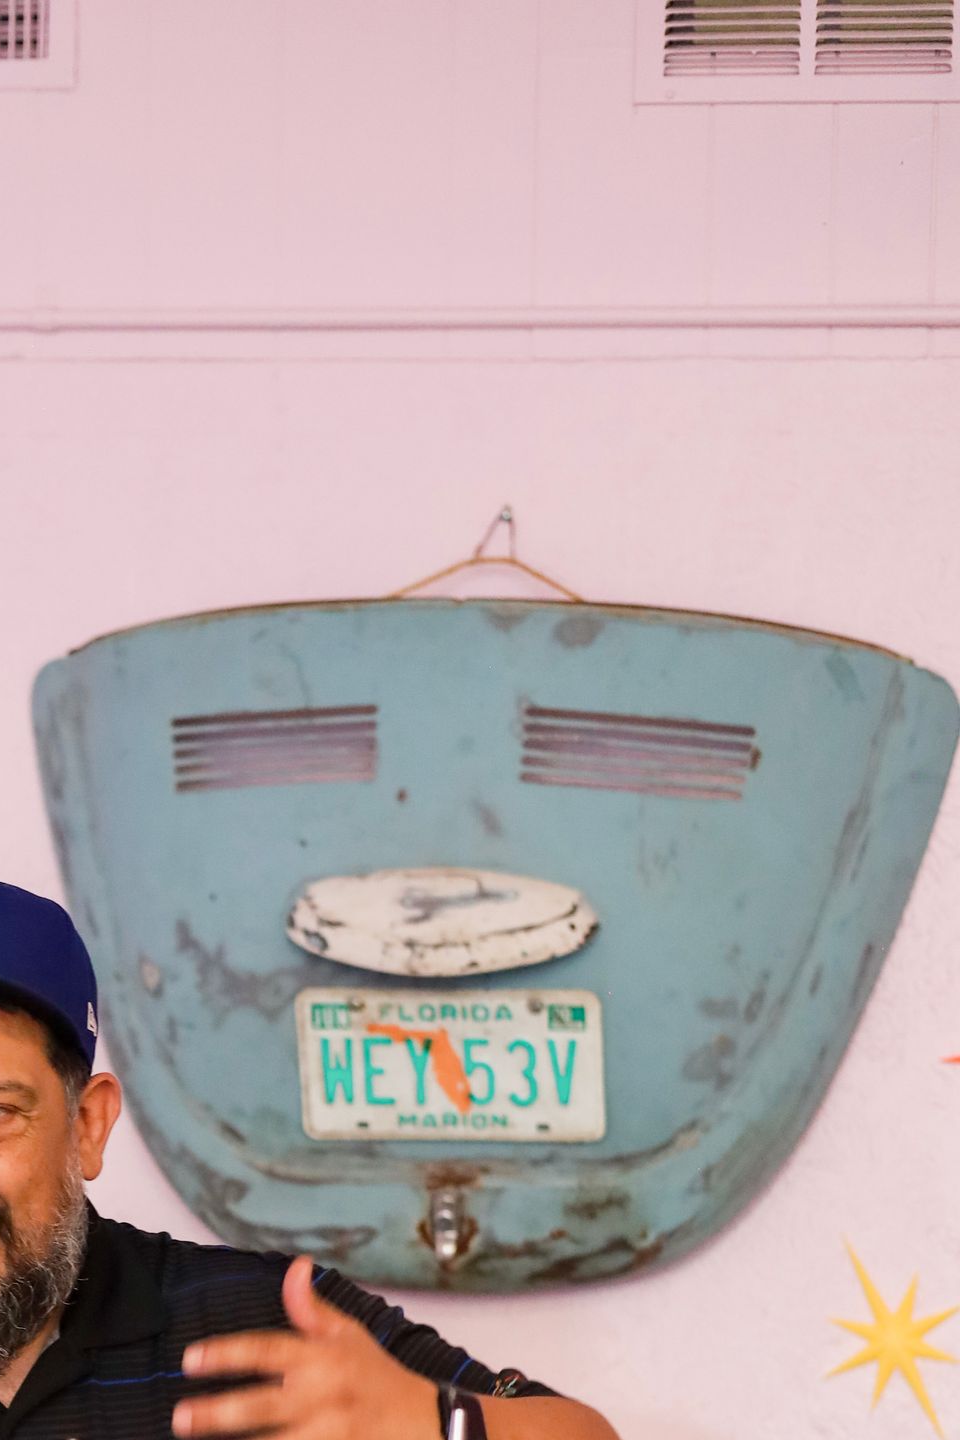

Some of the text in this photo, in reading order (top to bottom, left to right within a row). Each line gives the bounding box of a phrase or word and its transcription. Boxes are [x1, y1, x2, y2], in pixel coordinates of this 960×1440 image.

[378, 1003, 514, 1023] FLORIDA
[320, 1037, 578, 1108] WEY 53V
[397, 1113, 510, 1129] MARION
